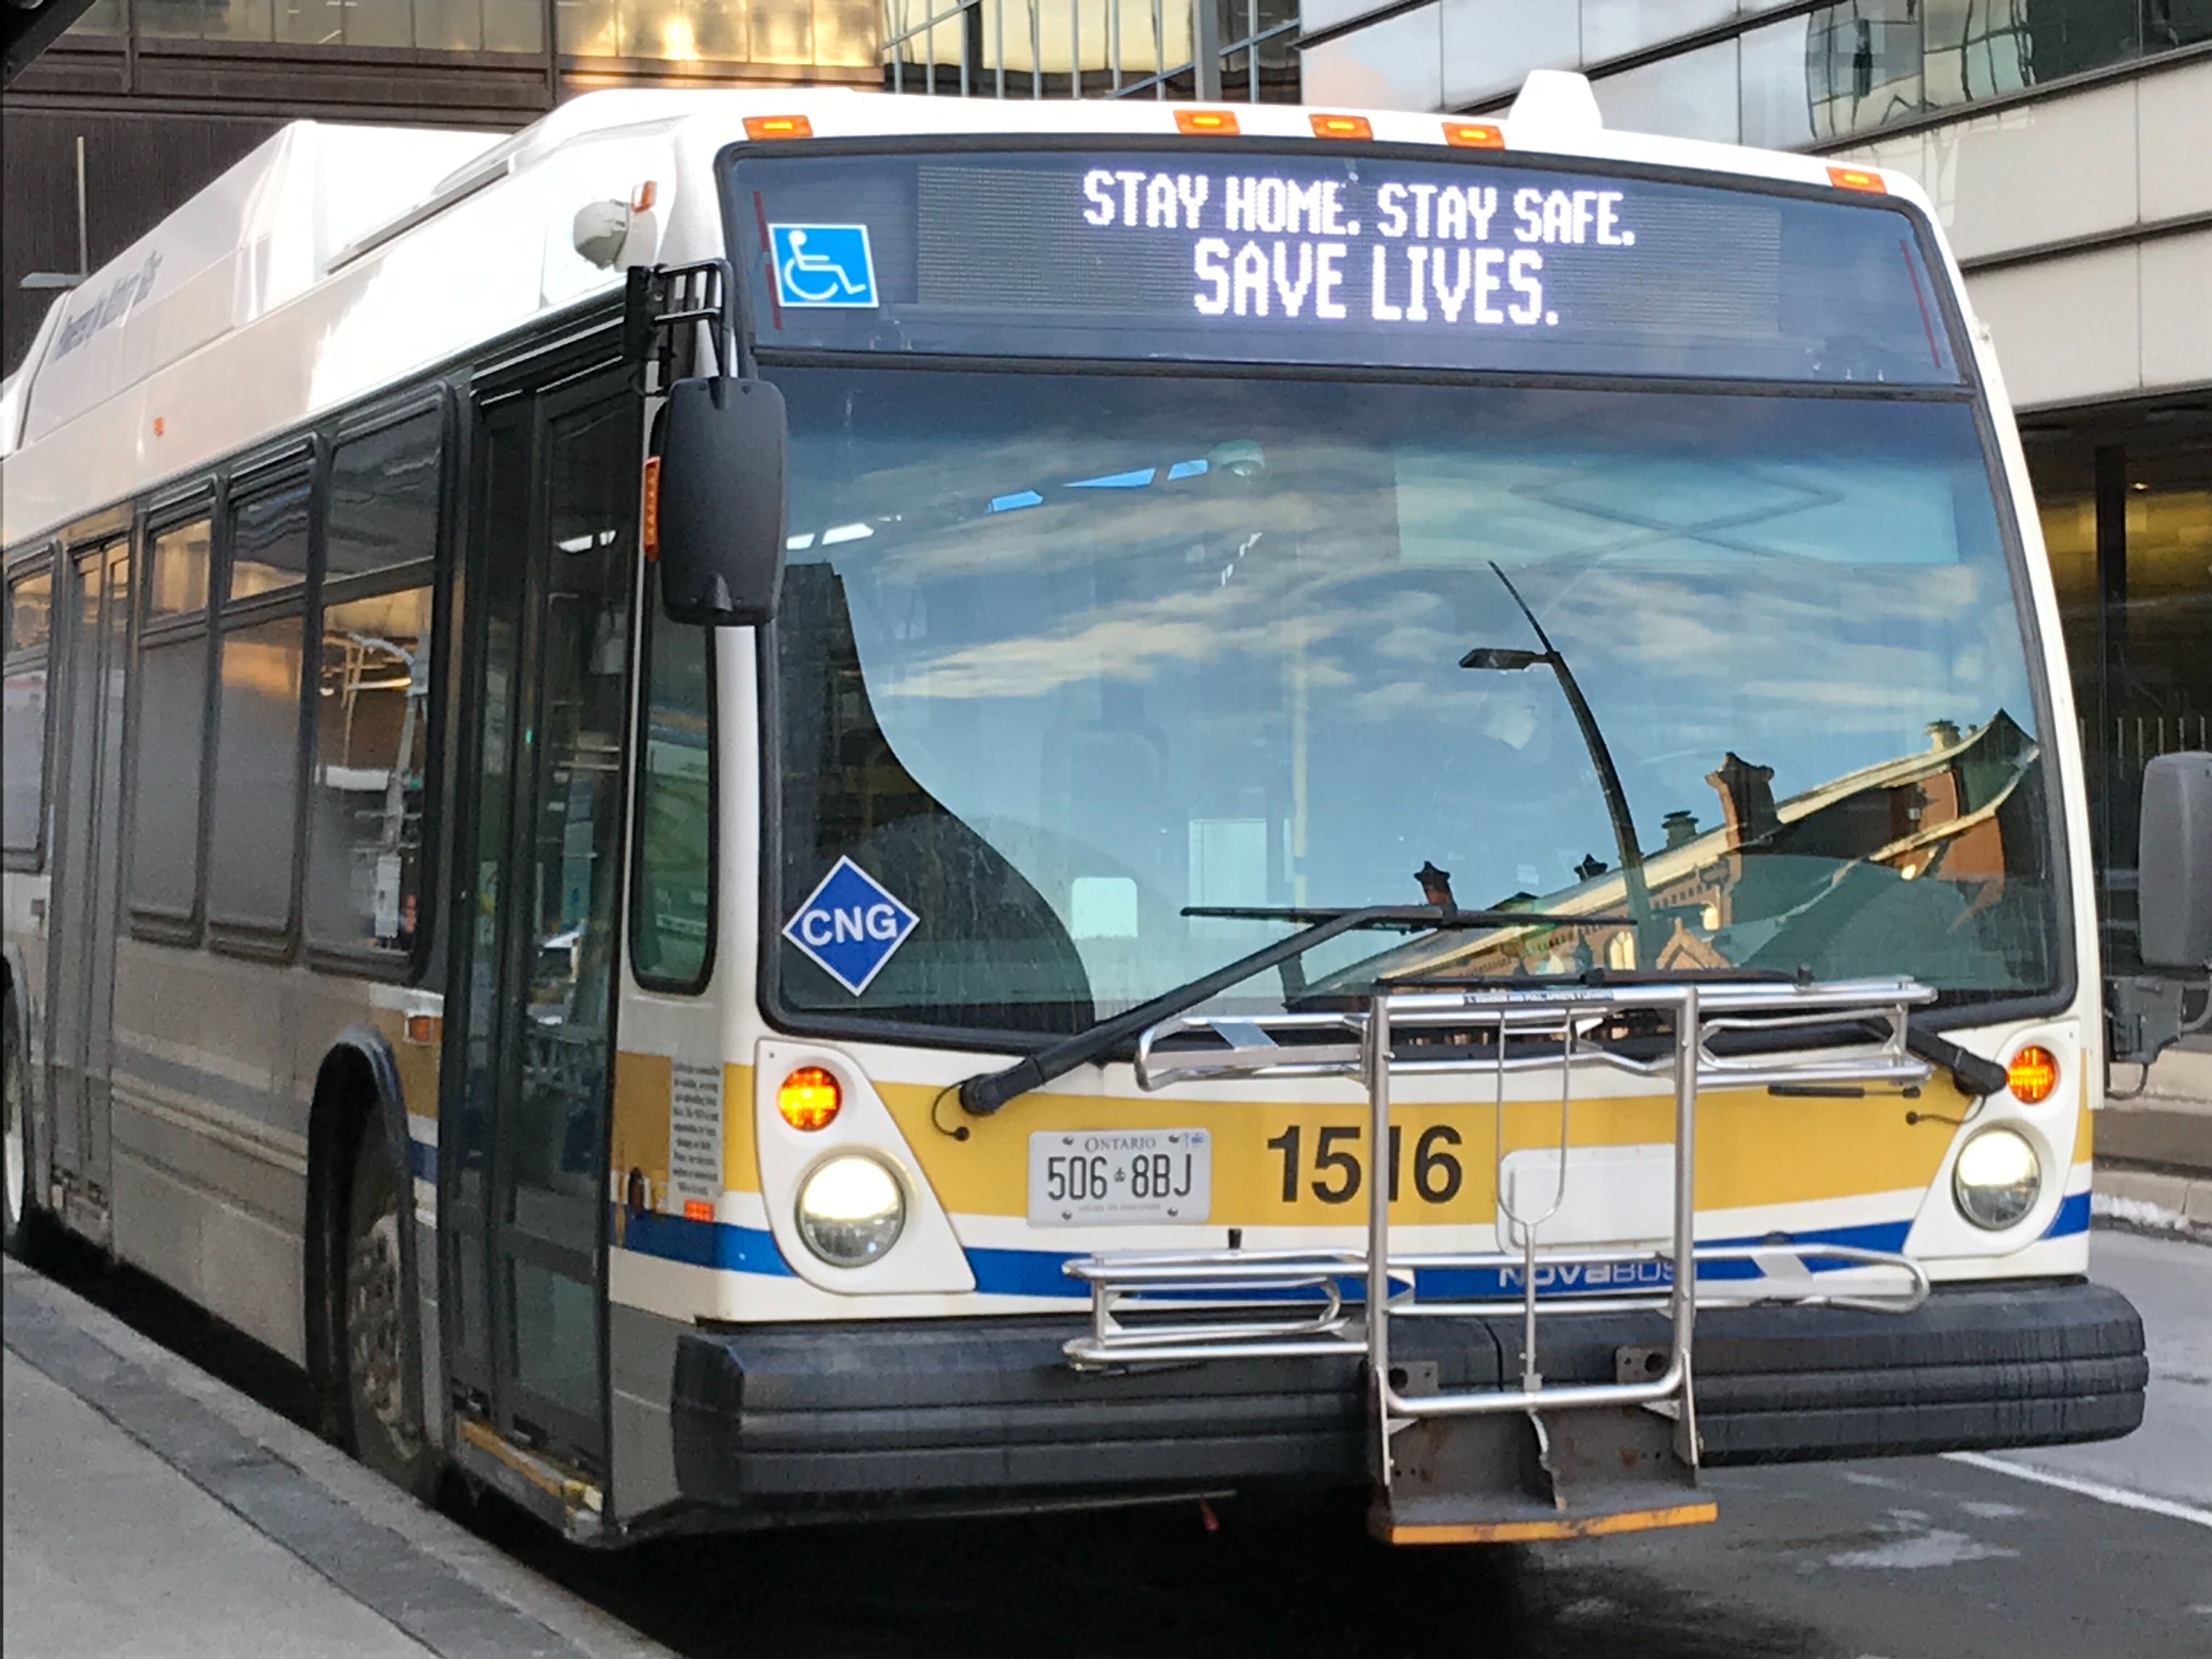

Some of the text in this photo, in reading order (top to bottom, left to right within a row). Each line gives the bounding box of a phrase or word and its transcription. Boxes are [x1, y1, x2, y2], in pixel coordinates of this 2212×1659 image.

[1084, 170, 1635, 246] STAY HOME. STAY SAFE.
[1194, 238, 1559, 325] SAVE LIVES.
[802, 904, 897, 946] CNG
[1085, 1137, 1156, 1152] ONTARIO
[1267, 1125, 1463, 1204] 1516
[1048, 1154, 1192, 1200] 506 8BJ
